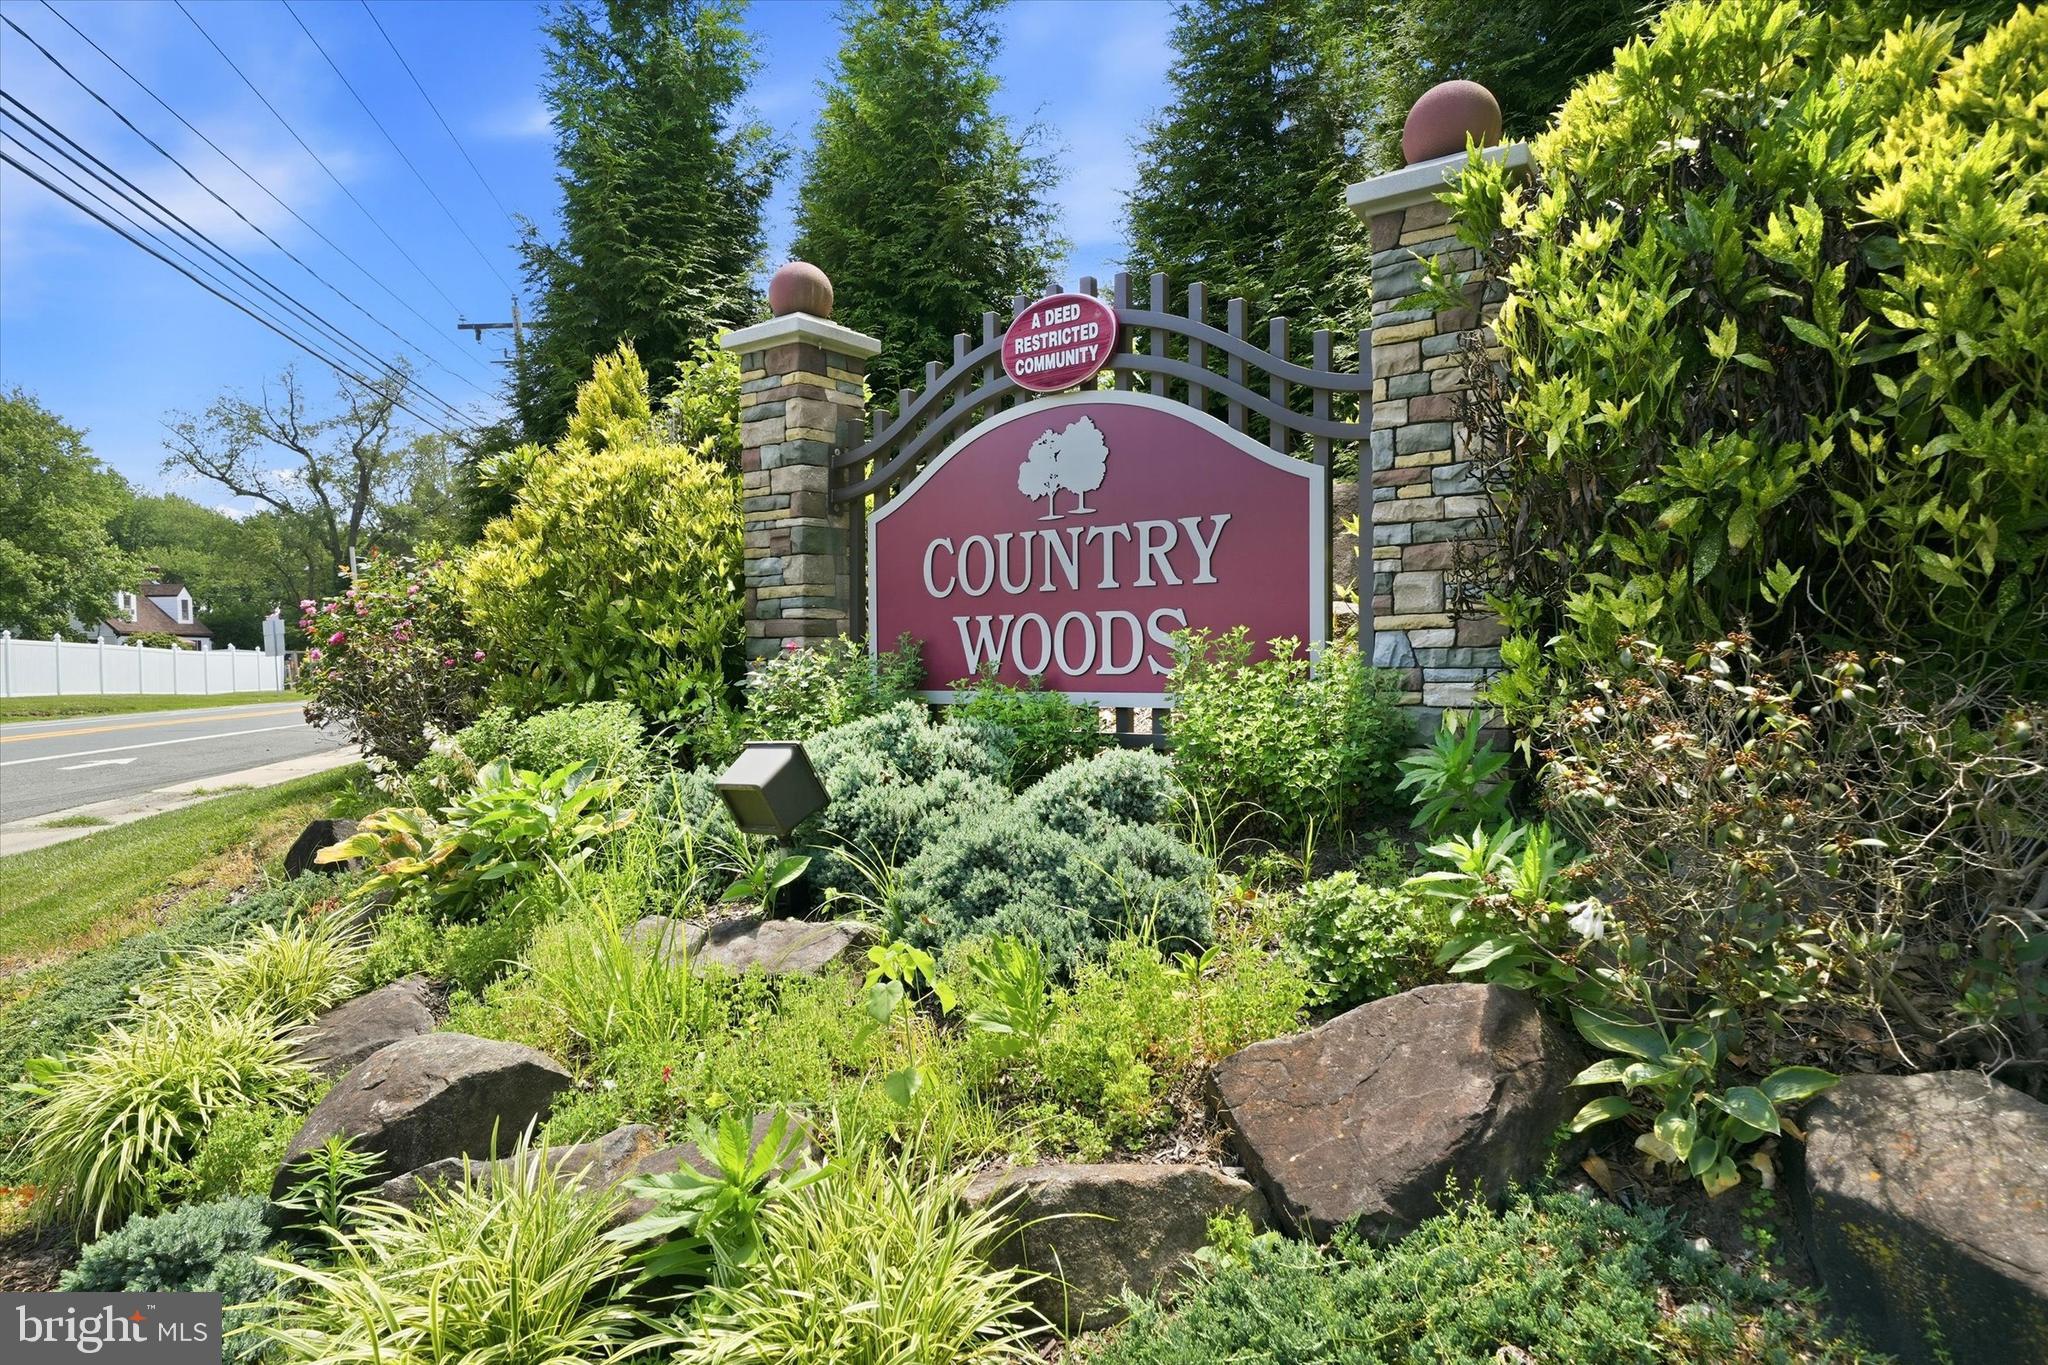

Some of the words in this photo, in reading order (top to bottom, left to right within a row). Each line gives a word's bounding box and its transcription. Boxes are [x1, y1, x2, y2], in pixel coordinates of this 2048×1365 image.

[1031, 312, 1041, 330] A
[1045, 303, 1081, 326] DEED
[1014, 322, 1099, 355] RESTRICTED
[1015, 344, 1099, 376] COMMUNITY
[922, 513, 1232, 599] COUNTRY
[953, 607, 1190, 677] WOODS
